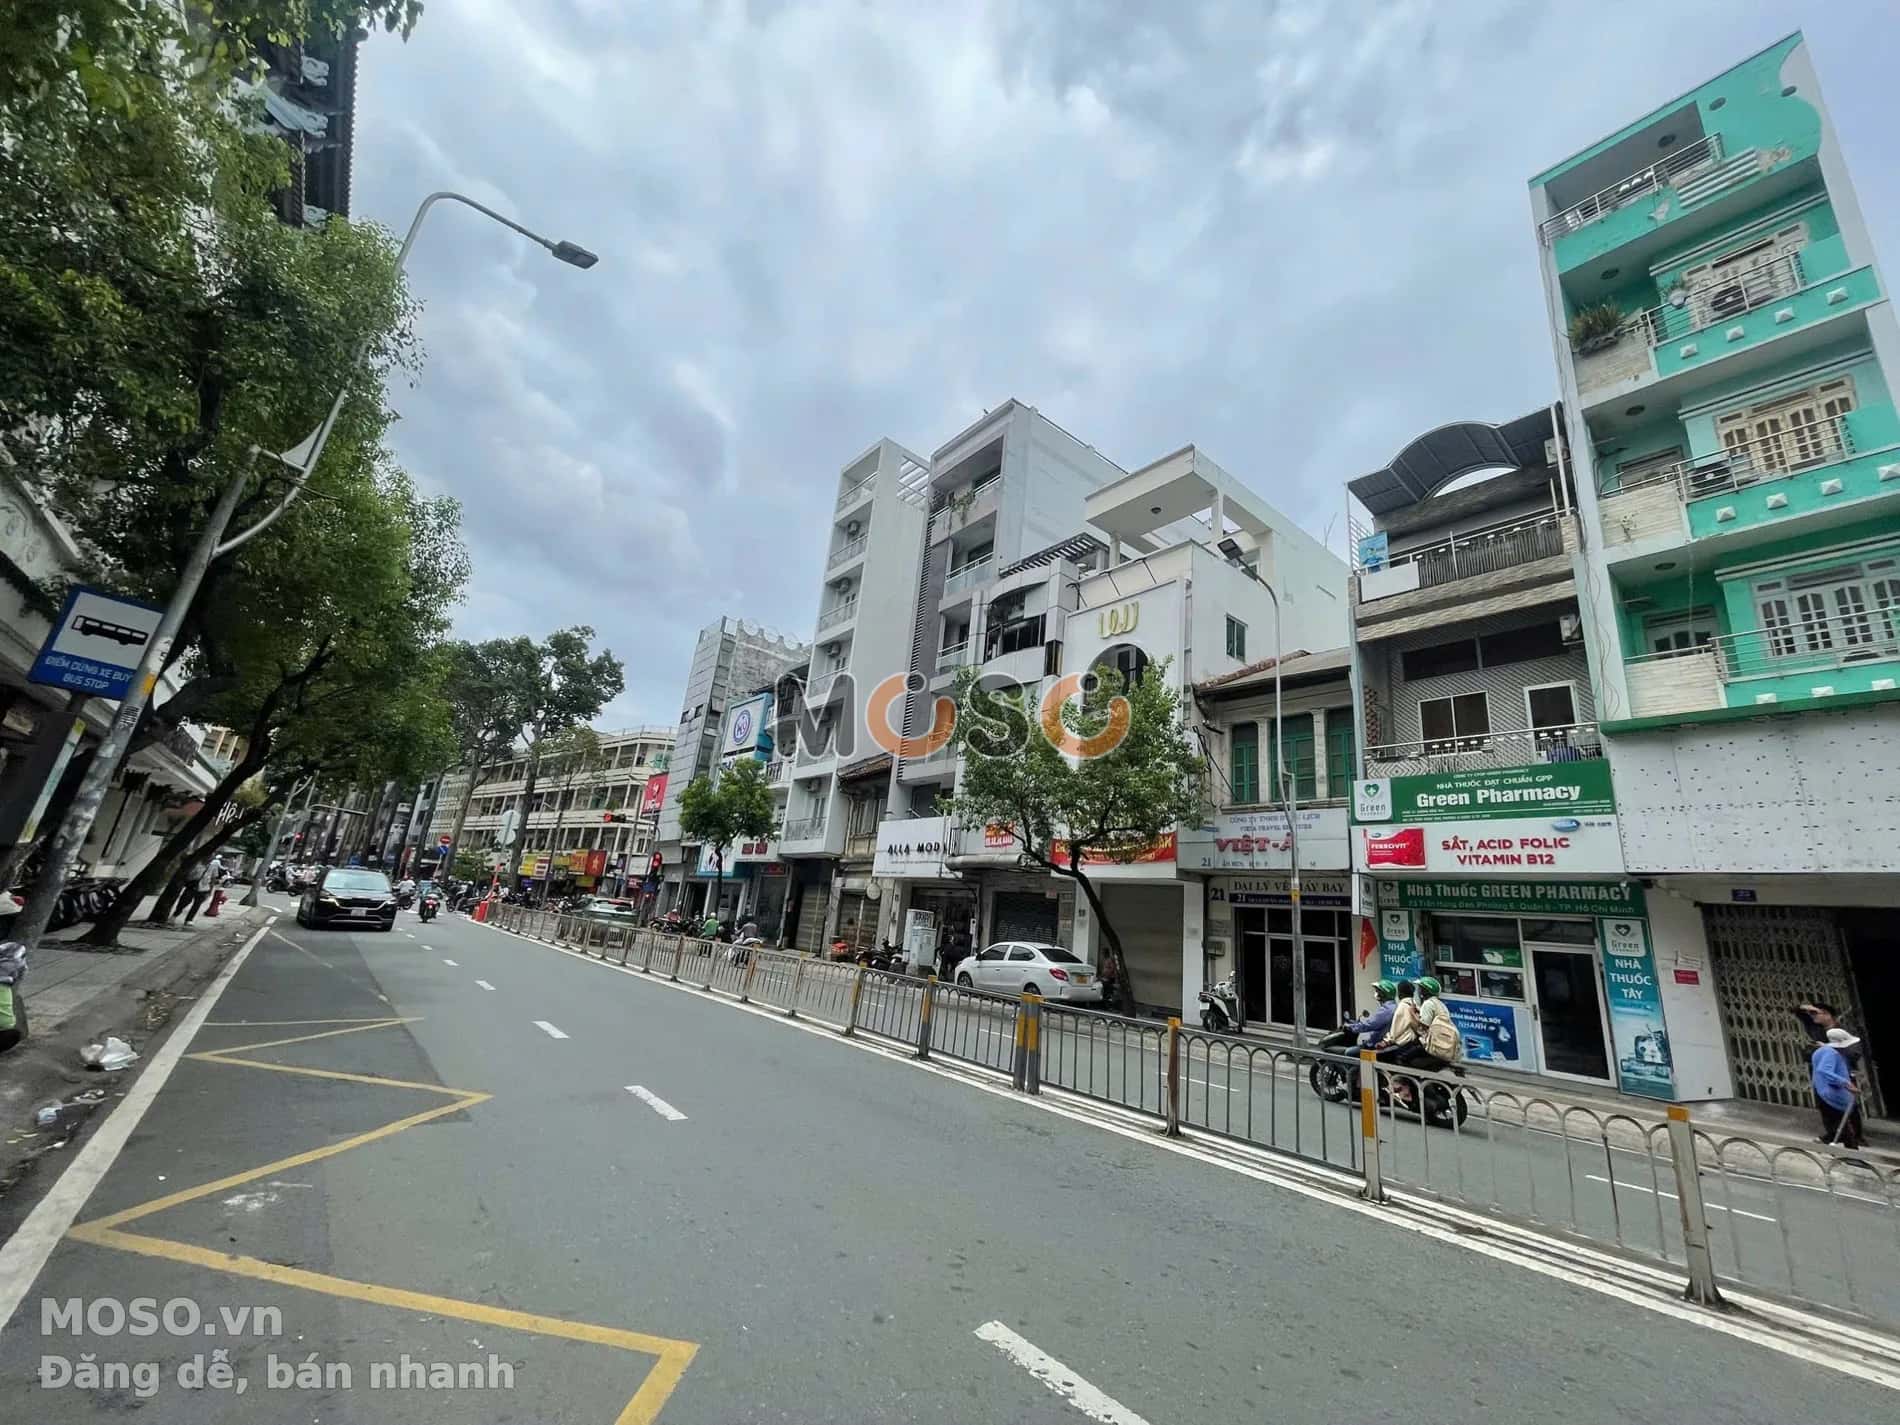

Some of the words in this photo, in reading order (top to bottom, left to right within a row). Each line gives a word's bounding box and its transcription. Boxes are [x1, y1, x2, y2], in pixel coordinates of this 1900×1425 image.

[63, 673, 83, 685] BUS
[83, 678, 109, 689] STOP
[1535, 774, 1553, 782] GPP
[1417, 792, 1470, 807] Green
[1476, 784, 1581, 804] Pharmacy
[1360, 803, 1386, 813] Green
[1441, 835, 1473, 851] SẮT,
[1477, 839, 1514, 850] ACID
[1520, 837, 1570, 849] FOLIC
[1201, 857, 1212, 867] 21
[1456, 854, 1522, 865] VITAMIN
[1527, 853, 1555, 865] B12
[1322, 882, 1345, 893] BAY
[1407, 884, 1434, 897] Nhà
[1435, 883, 1478, 897] Thuốc
[1481, 884, 1531, 898] GREEN
[1535, 885, 1631, 900] PHARMACY
[1210, 888, 1225, 900] 21
[1388, 942, 1406, 951] NHÀ
[1611, 938, 1640, 949] Green
[1384, 953, 1412, 964] THUỐC
[1615, 957, 1642, 969] NHÀ
[1609, 972, 1651, 985] THUỐC
[1622, 987, 1643, 999] TÂY
